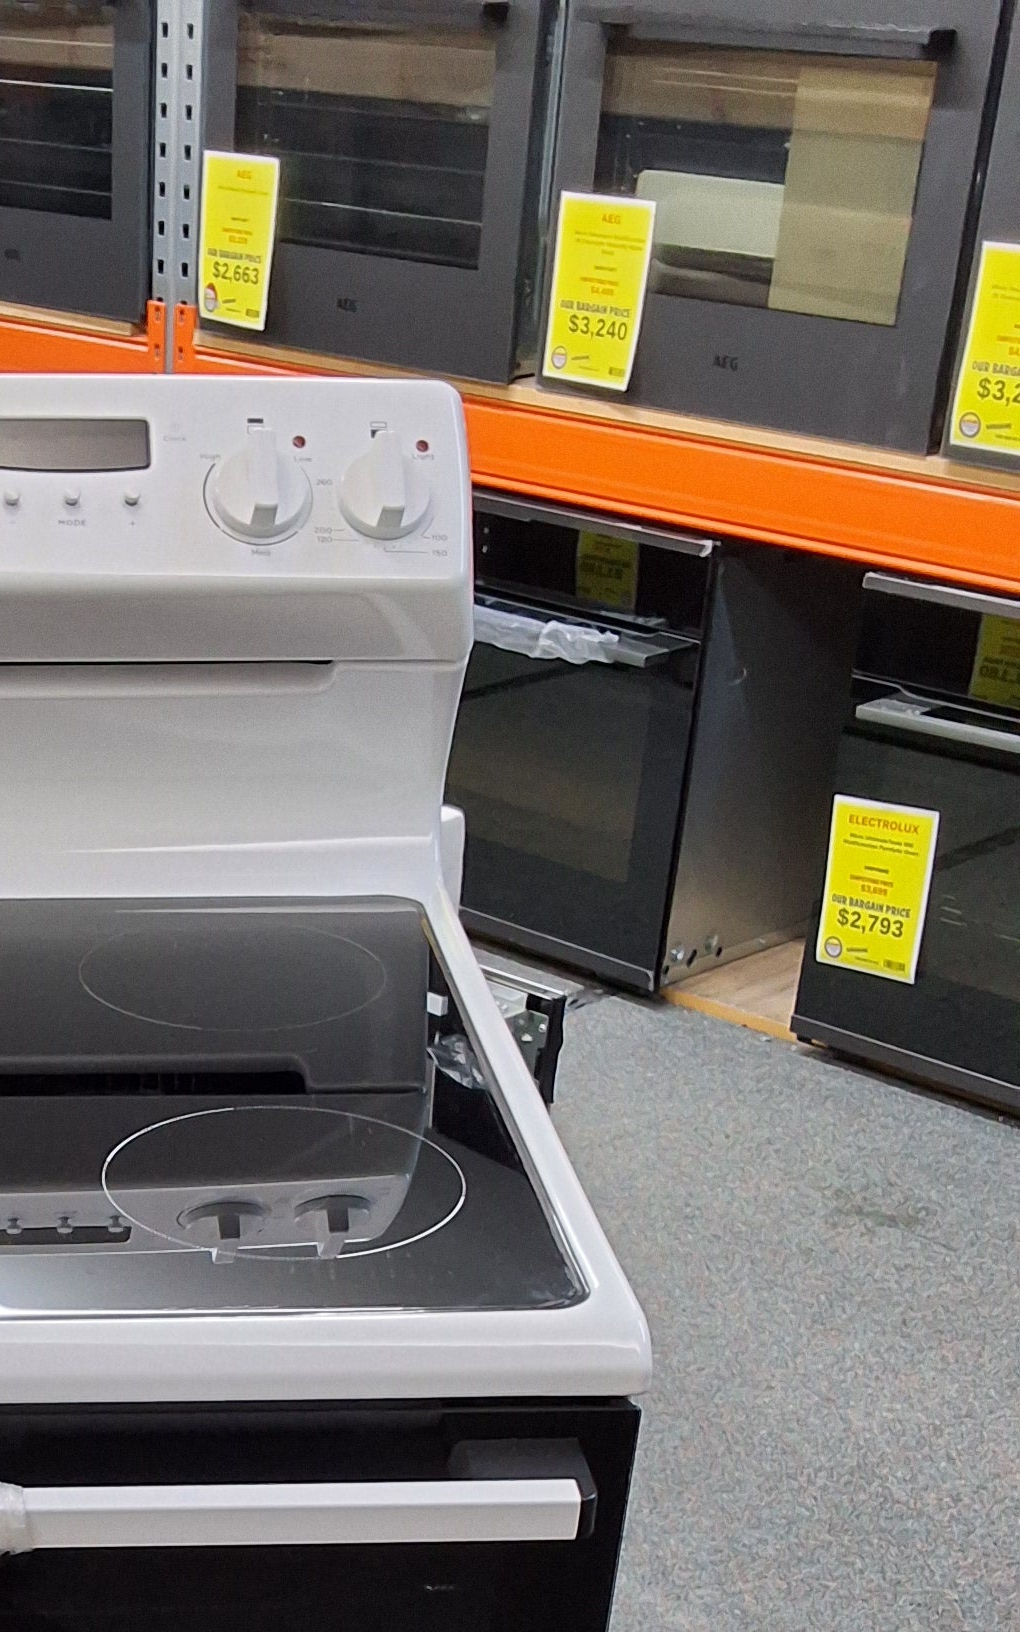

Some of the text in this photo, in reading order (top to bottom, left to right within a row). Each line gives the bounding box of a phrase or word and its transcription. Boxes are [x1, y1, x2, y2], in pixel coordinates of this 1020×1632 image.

[602, 213, 621, 225] AEG
[213, 261, 259, 285] $2,663
[576, 301, 607, 315] BARGAIN
[609, 306, 630, 318] PRICE
[568, 314, 628, 340] $3,240
[712, 354, 738, 371] AEG
[972, 360, 990, 373] OUR
[58, 519, 87, 527] MODE
[848, 814, 920, 834] ELECTROLUX
[832, 893, 911, 919] OUR BARGAIN PRICE
[836, 908, 904, 938] $2,793
